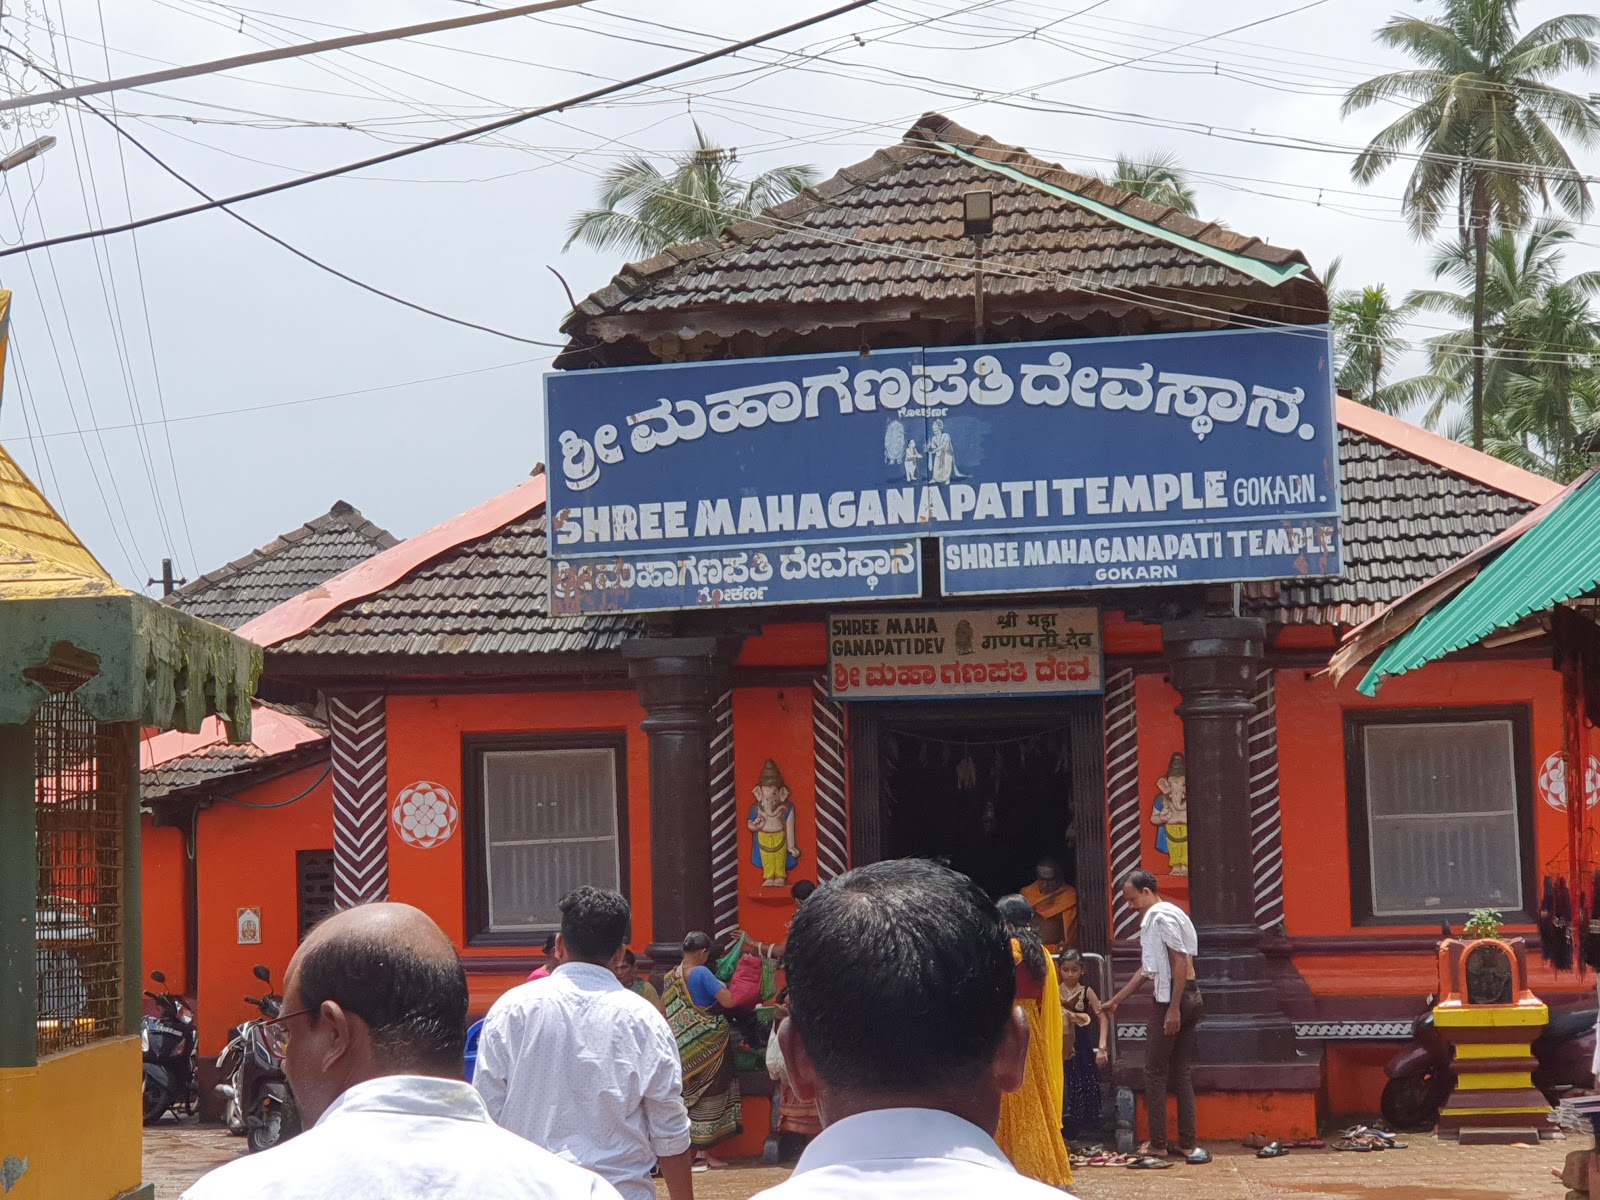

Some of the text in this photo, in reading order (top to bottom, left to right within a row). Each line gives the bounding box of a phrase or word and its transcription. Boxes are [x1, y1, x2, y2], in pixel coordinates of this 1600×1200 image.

[559, 424, 624, 491] ಶ್ರೀ
[626, 355, 1014, 453] ಮಹಾಗಣಪತಿ
[553, 501, 689, 545] SHREE
[694, 480, 1048, 537] MAHAGANAPATI
[1053, 471, 1228, 515] TEMPLE
[946, 526, 1336, 570] SHREE MAHAGANAPATI TEMPLE
[596, 552, 772, 591] ಮಹಾಗಣಪತಿ
[780, 543, 914, 590] ದೇವಸ್ಥಾನ
[1095, 565, 1178, 580] GOKARN
[832, 617, 938, 636] SHREE MAHA
[996, 611, 1018, 629] श्री
[832, 637, 945, 657] GANAPATI DEV
[834, 663, 860, 692] ಶ್ರೀ
[1035, 655, 1090, 682] ದೇವ
